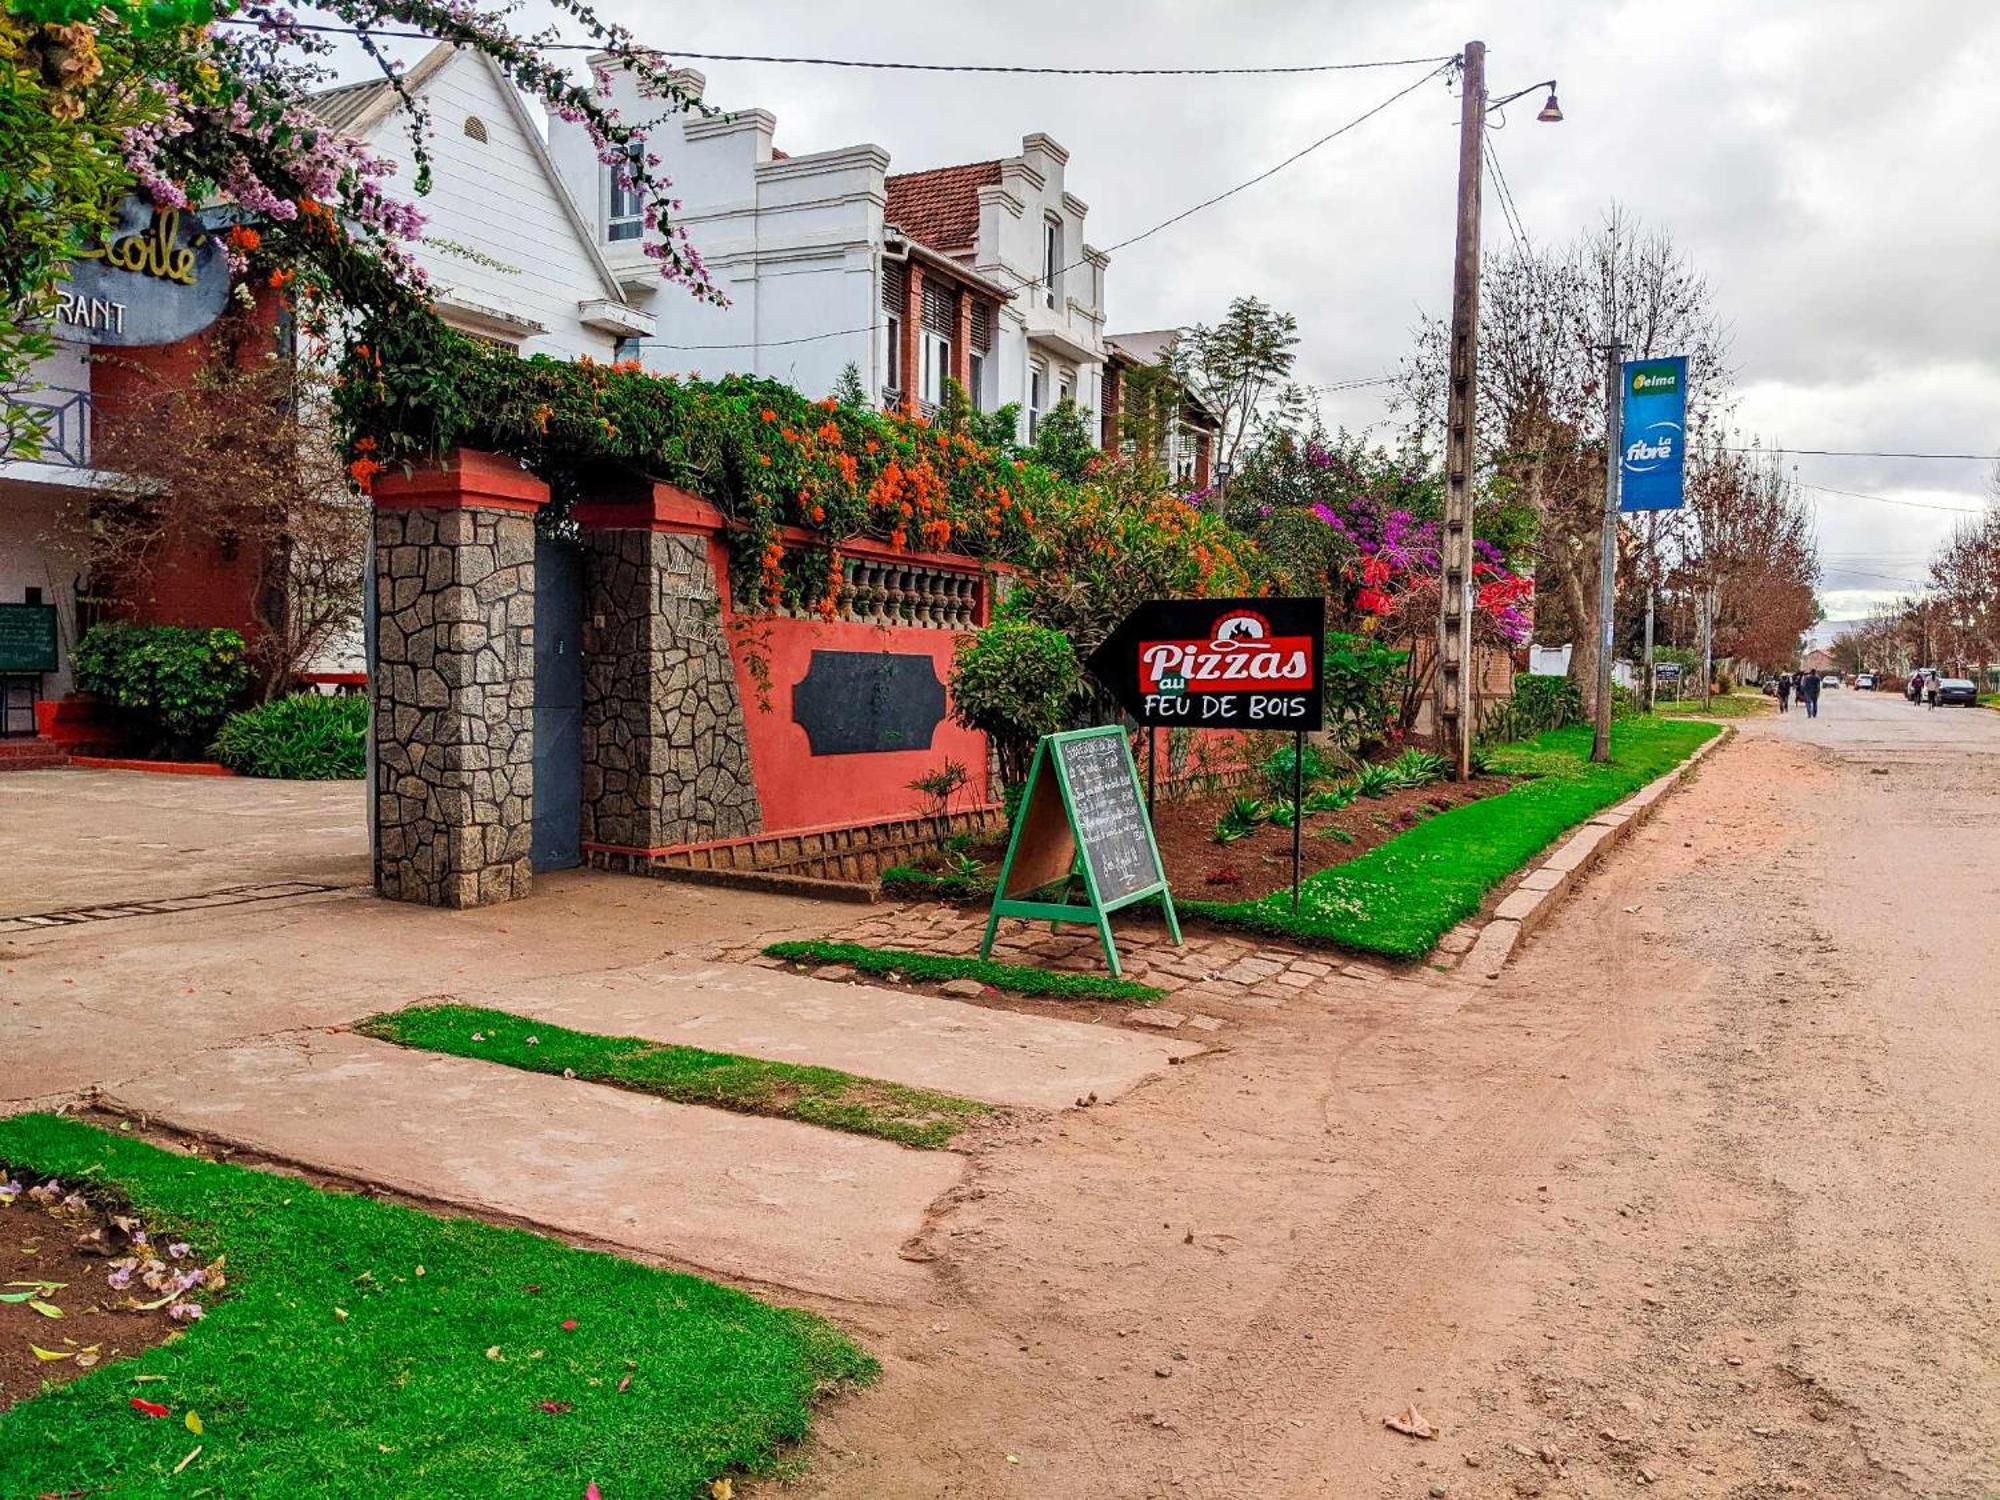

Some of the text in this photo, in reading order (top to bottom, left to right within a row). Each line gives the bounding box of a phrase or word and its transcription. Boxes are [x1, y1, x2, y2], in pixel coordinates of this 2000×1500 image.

[1626, 440, 1671, 461] fibre
[1658, 437, 1671, 446] La
[1143, 644, 1307, 680] Pizzas
[1159, 677, 1185, 690] au
[1144, 694, 1190, 717] FEU
[1202, 695, 1237, 719] DE
